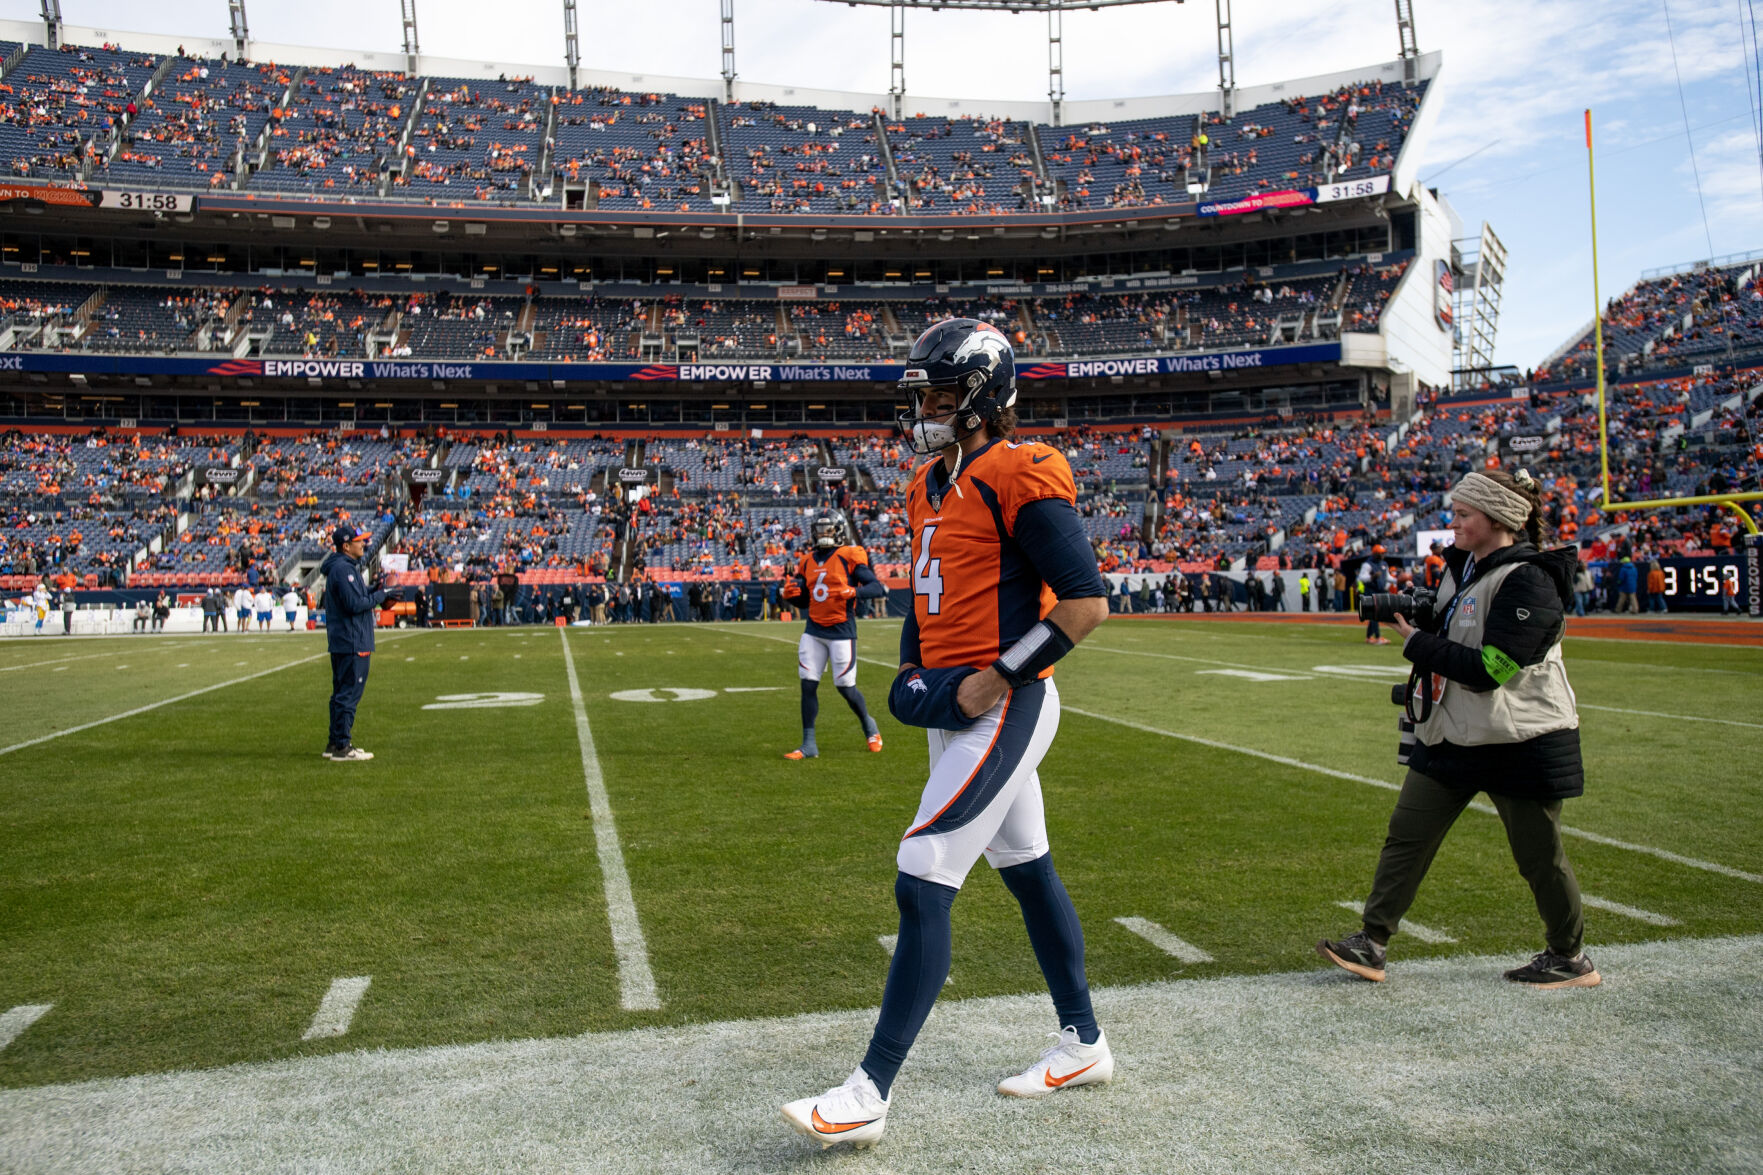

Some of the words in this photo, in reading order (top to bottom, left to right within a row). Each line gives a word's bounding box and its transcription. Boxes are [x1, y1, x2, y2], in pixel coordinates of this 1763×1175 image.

[15, 190, 29, 198] TO
[1331, 182, 1374, 199] 31:58
[120, 192, 178, 210] 31:58
[1200, 201, 1251, 214] COUNTDOWN
[1252, 198, 1263, 207] TO
[0, 355, 22, 370] xt
[264, 360, 364, 377] EMPOWER
[373, 362, 429, 378] What's
[432, 364, 472, 379] Next
[1068, 359, 1159, 378] EMPOWER
[1166, 355, 1219, 372] What's
[1223, 352, 1262, 369] Next
[680, 365, 771, 380] EMPOWER
[779, 366, 830, 380] What's
[833, 366, 871, 380] Next
[121, 419, 136, 428] 123
[339, 420, 354, 429] 124
[914, 525, 945, 616] 4
[812, 572, 830, 604] 6
